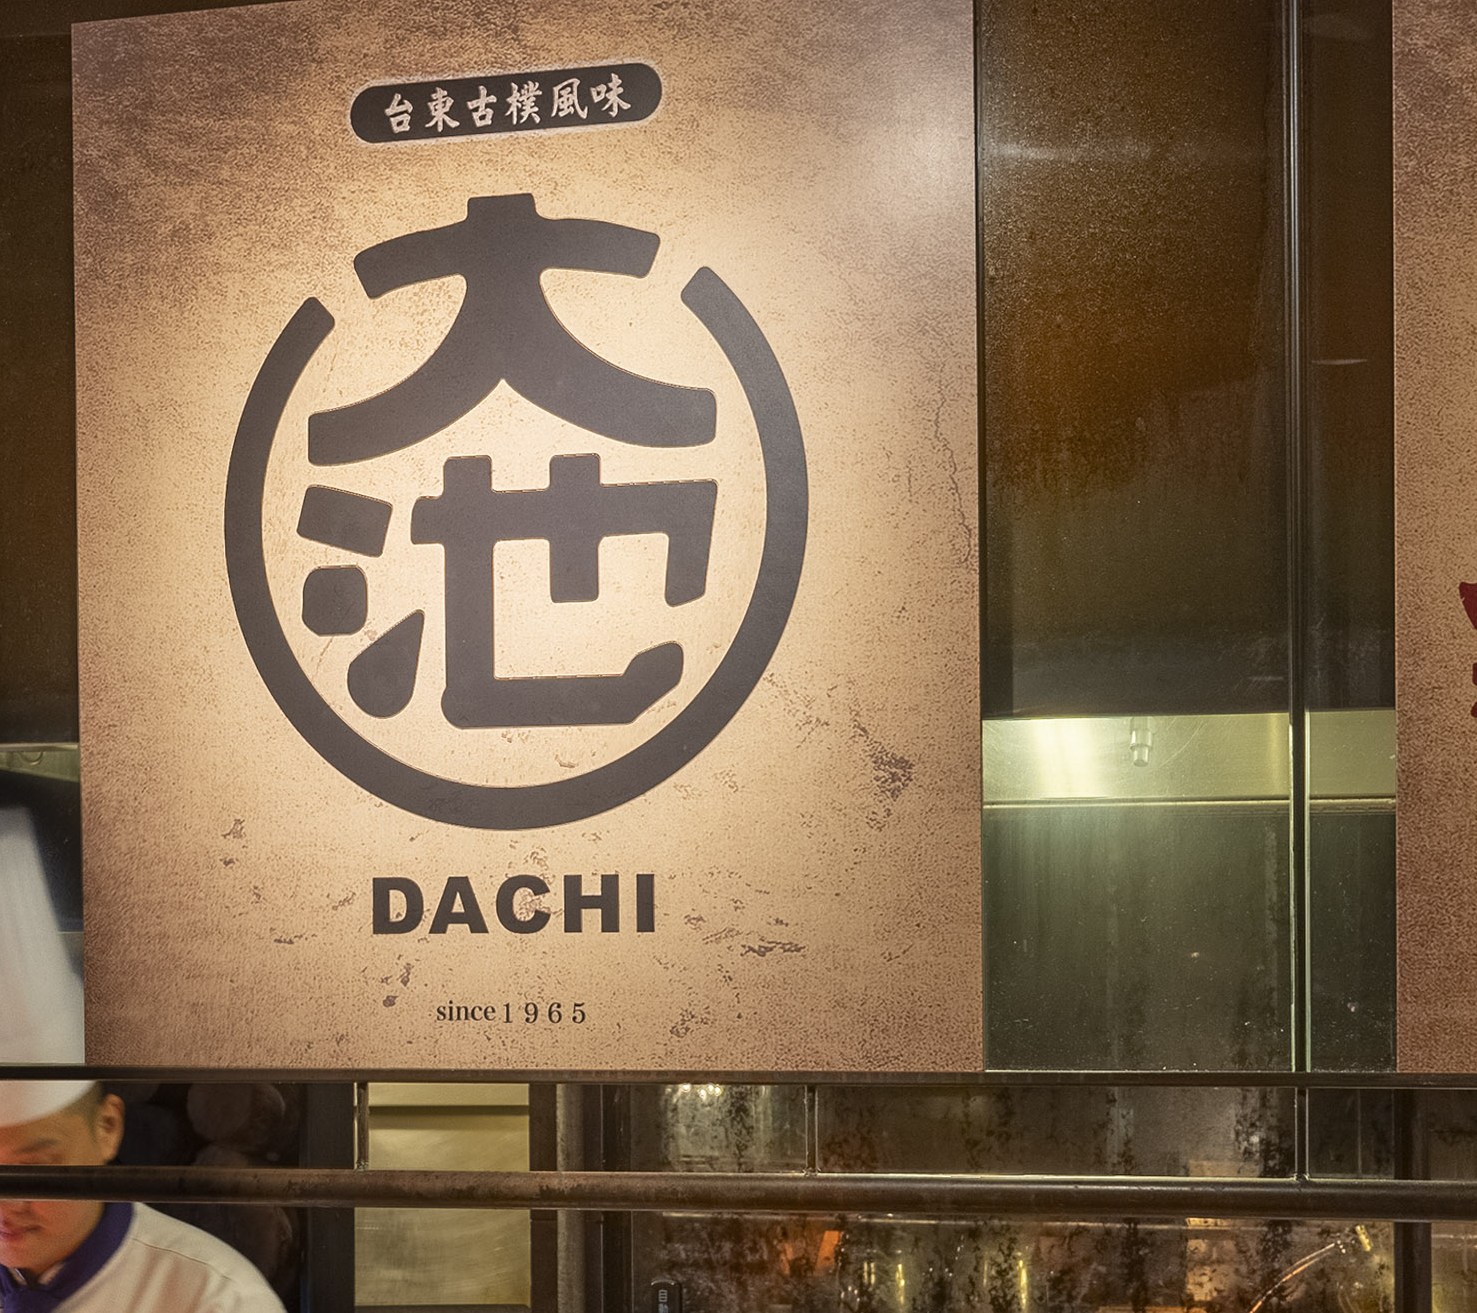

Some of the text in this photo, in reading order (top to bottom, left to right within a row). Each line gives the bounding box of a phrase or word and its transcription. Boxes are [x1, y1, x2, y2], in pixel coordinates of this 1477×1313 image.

[384, 73, 631, 133] 台東古樸風味
[372, 873, 655, 934] DACHI
